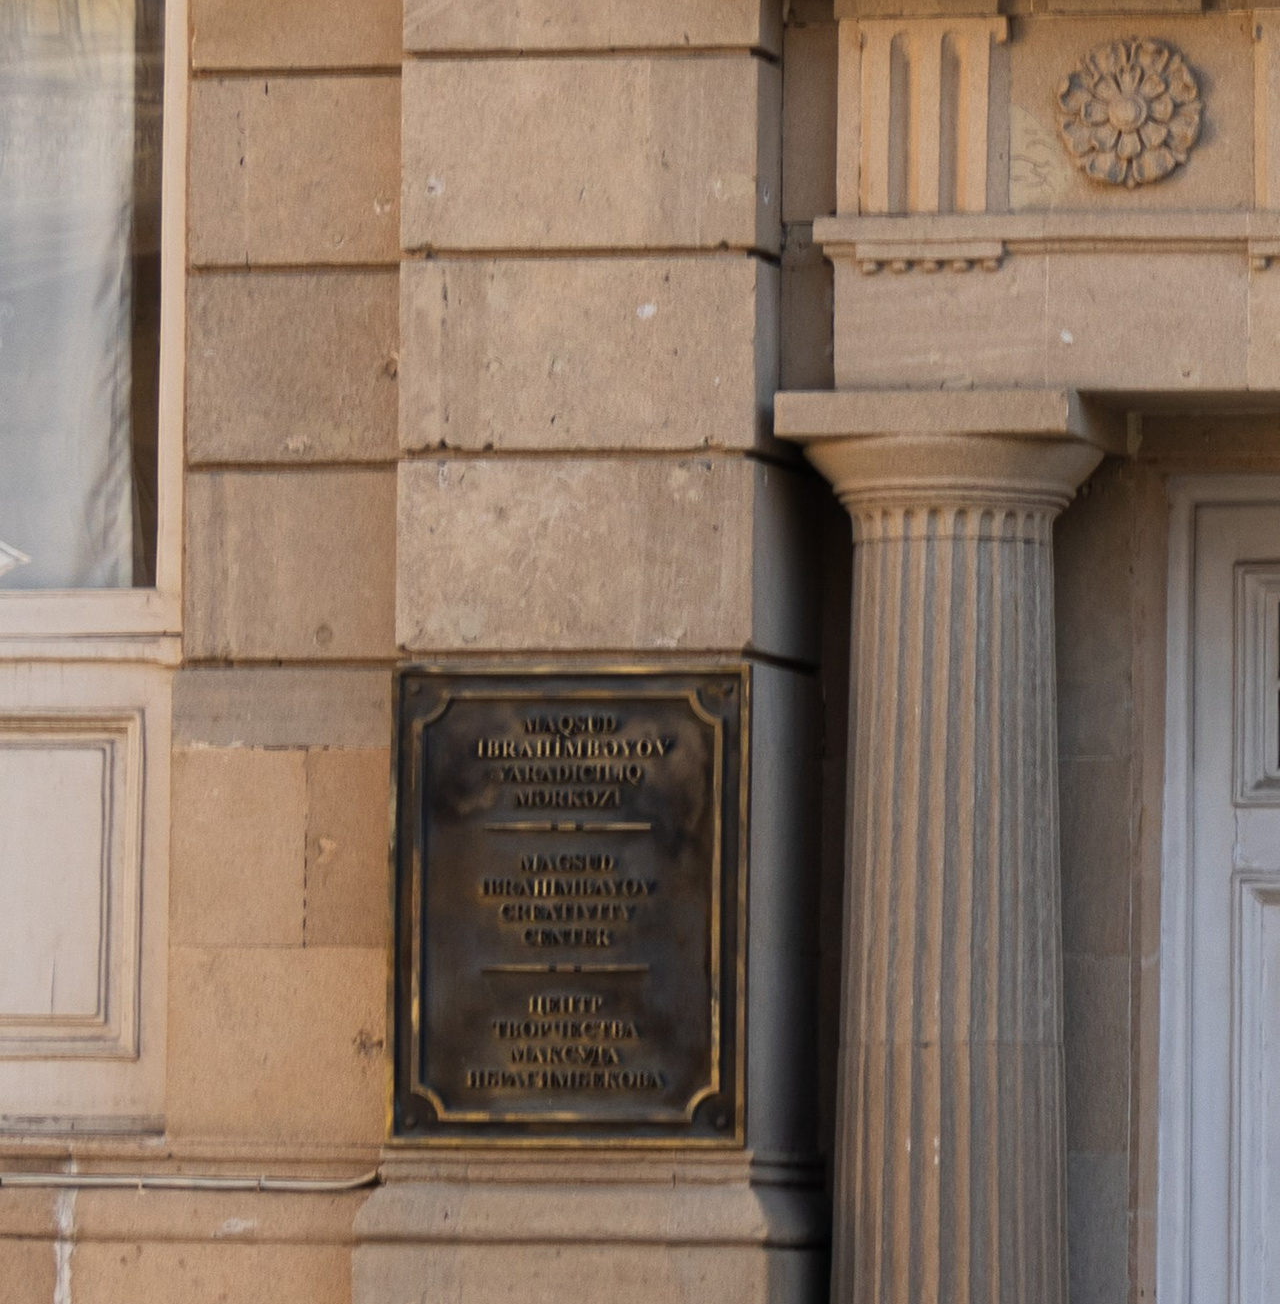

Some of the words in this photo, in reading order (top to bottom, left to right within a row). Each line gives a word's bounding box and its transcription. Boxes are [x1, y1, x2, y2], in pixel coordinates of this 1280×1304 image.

[523, 714, 617, 736] MAQSUD
[521, 853, 615, 871] MAGSUD
[500, 902, 635, 921] CREATIVITY
[522, 927, 611, 945] CENTER
[528, 995, 602, 1016] ЦЕНТР
[491, 1019, 639, 1038] ТВОРЧЕСТВА
[511, 1045, 620, 1066] МАКСУДА
[466, 1070, 666, 1088] ИБРАГИМБЕКОВА
